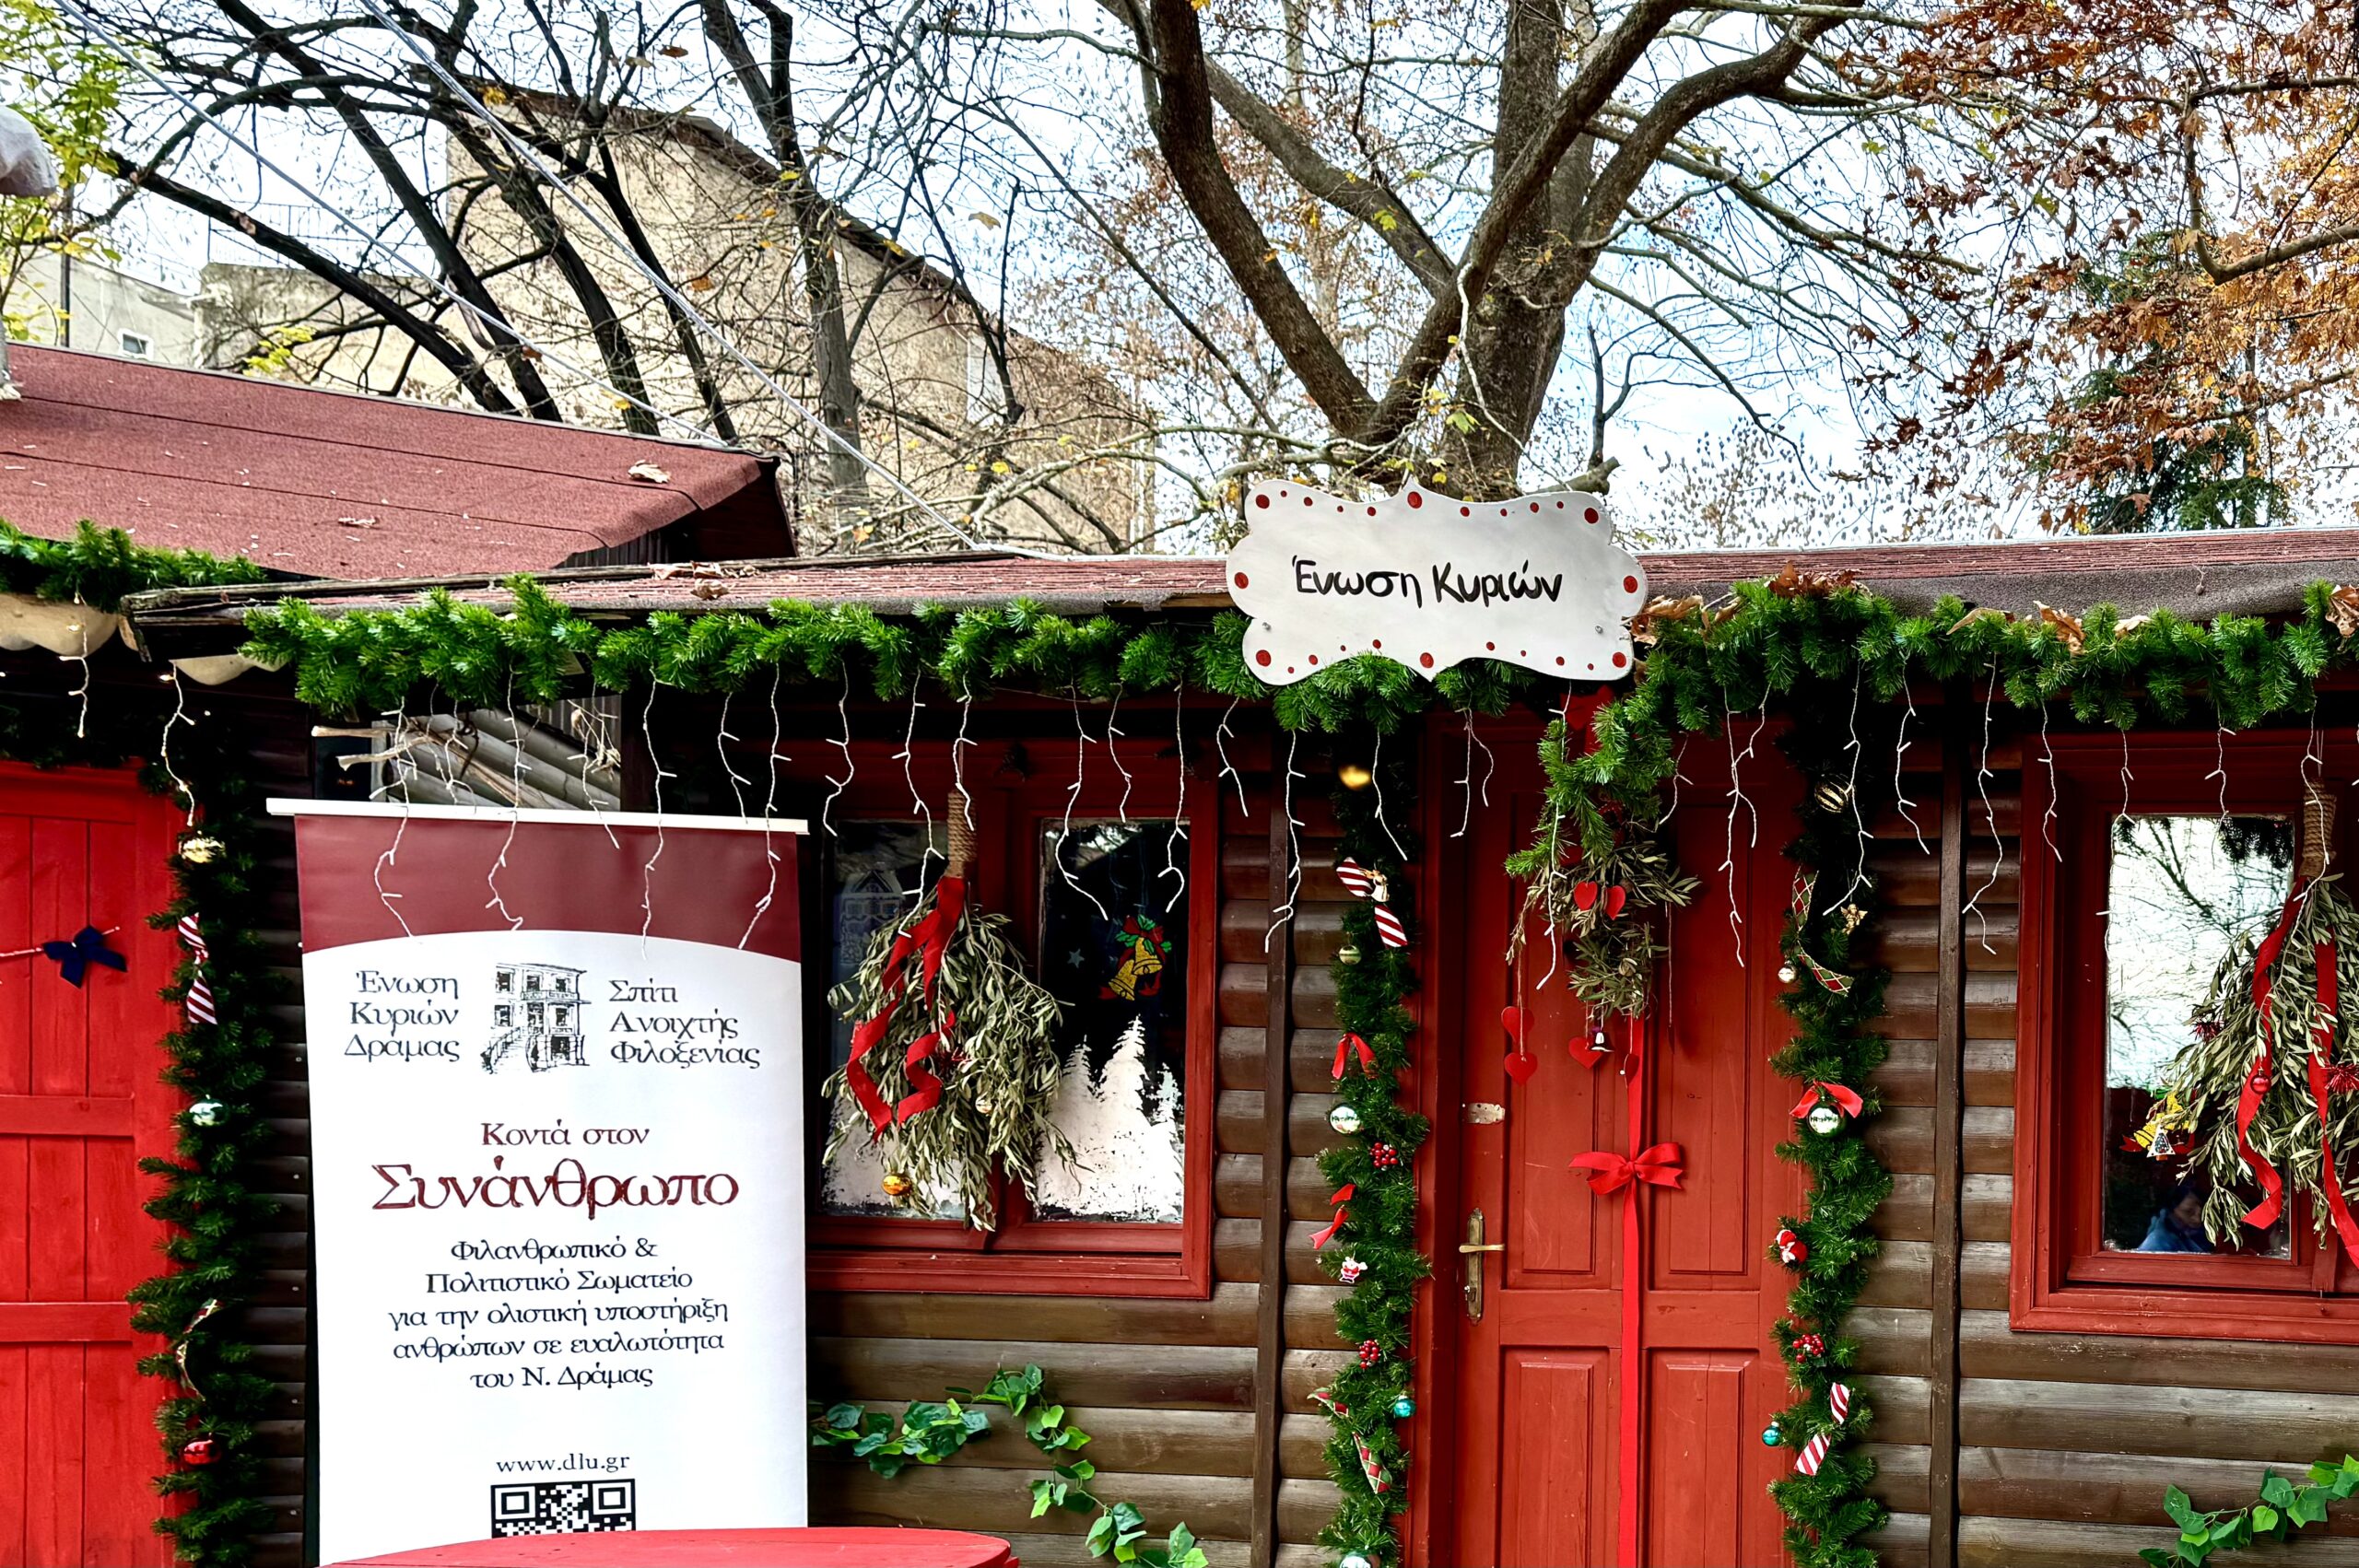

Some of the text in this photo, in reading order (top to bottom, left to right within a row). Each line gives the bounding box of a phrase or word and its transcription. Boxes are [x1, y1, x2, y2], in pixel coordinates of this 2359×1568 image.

[1291, 554, 1564, 610] Ένωση Κυριών
[356, 970, 459, 1000] Ένωση
[608, 977, 679, 1003] Σπίτι
[349, 999, 460, 1032] Κυριών
[609, 1008, 739, 1041] Ανοιχτής
[610, 1037, 761, 1070] Φιλοξενίας
[480, 1118, 651, 1146] Κοντά στον
[370, 1154, 740, 1222] Συνάνθρωπο
[451, 1235, 658, 1265] Φιλανθρωπικό &
[425, 1265, 693, 1294] Πολιτιστικό Σωματείο
[387, 1296, 729, 1332] για την ολιστική υποστήριξη
[393, 1328, 725, 1363] ανθρώπων σε ευαλωτότητα
[469, 1361, 653, 1391] του Ν. Δράμας
[496, 1452, 630, 1474] www.dlu.gr
